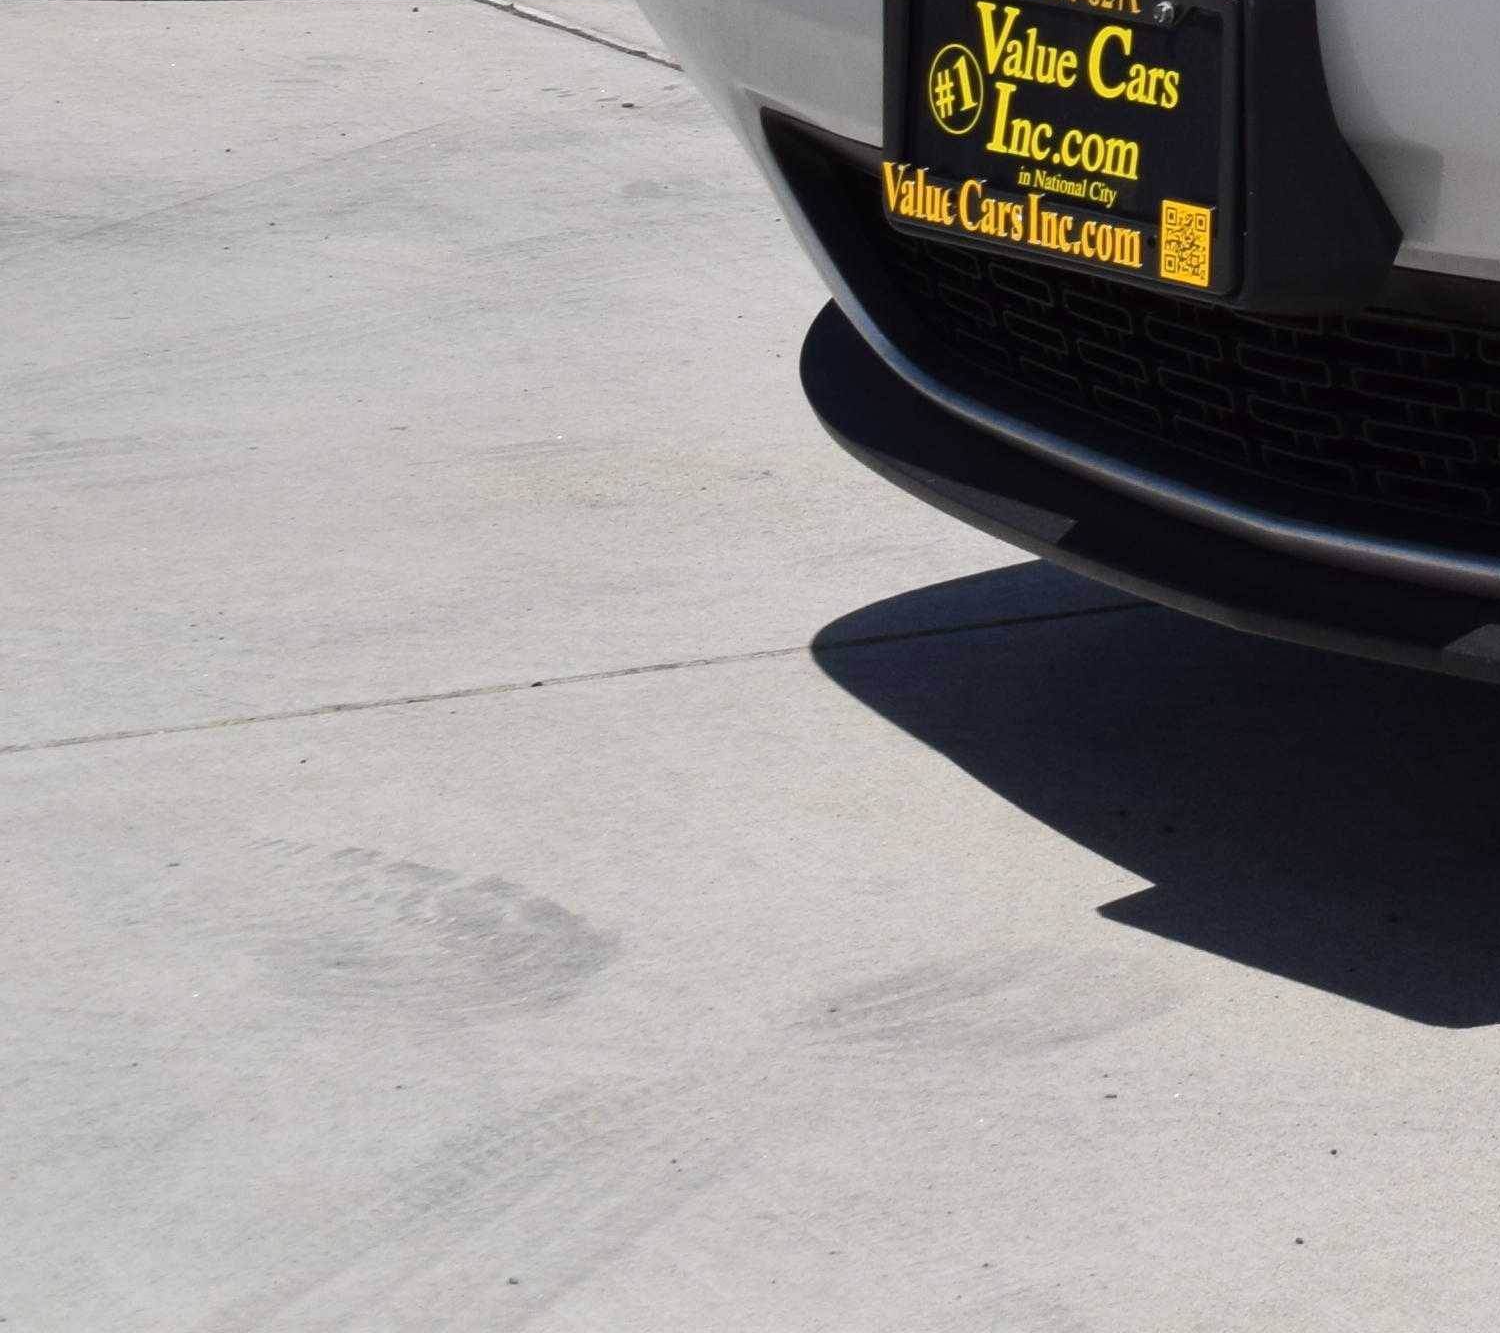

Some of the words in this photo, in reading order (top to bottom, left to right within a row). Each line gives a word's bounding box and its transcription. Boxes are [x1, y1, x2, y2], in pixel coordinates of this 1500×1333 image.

[934, 55, 978, 119] #1
[976, 0, 1078, 88] Value
[1088, 25, 1180, 109] Cars
[986, 81, 1139, 180] Inc.com
[882, 161, 957, 226] Value
[959, 178, 1025, 242] Cars
[1027, 192, 1143, 269] Inc.com
[1018, 165, 1031, 185] in
[1035, 169, 1087, 199] National
[1089, 181, 1117, 209] City
